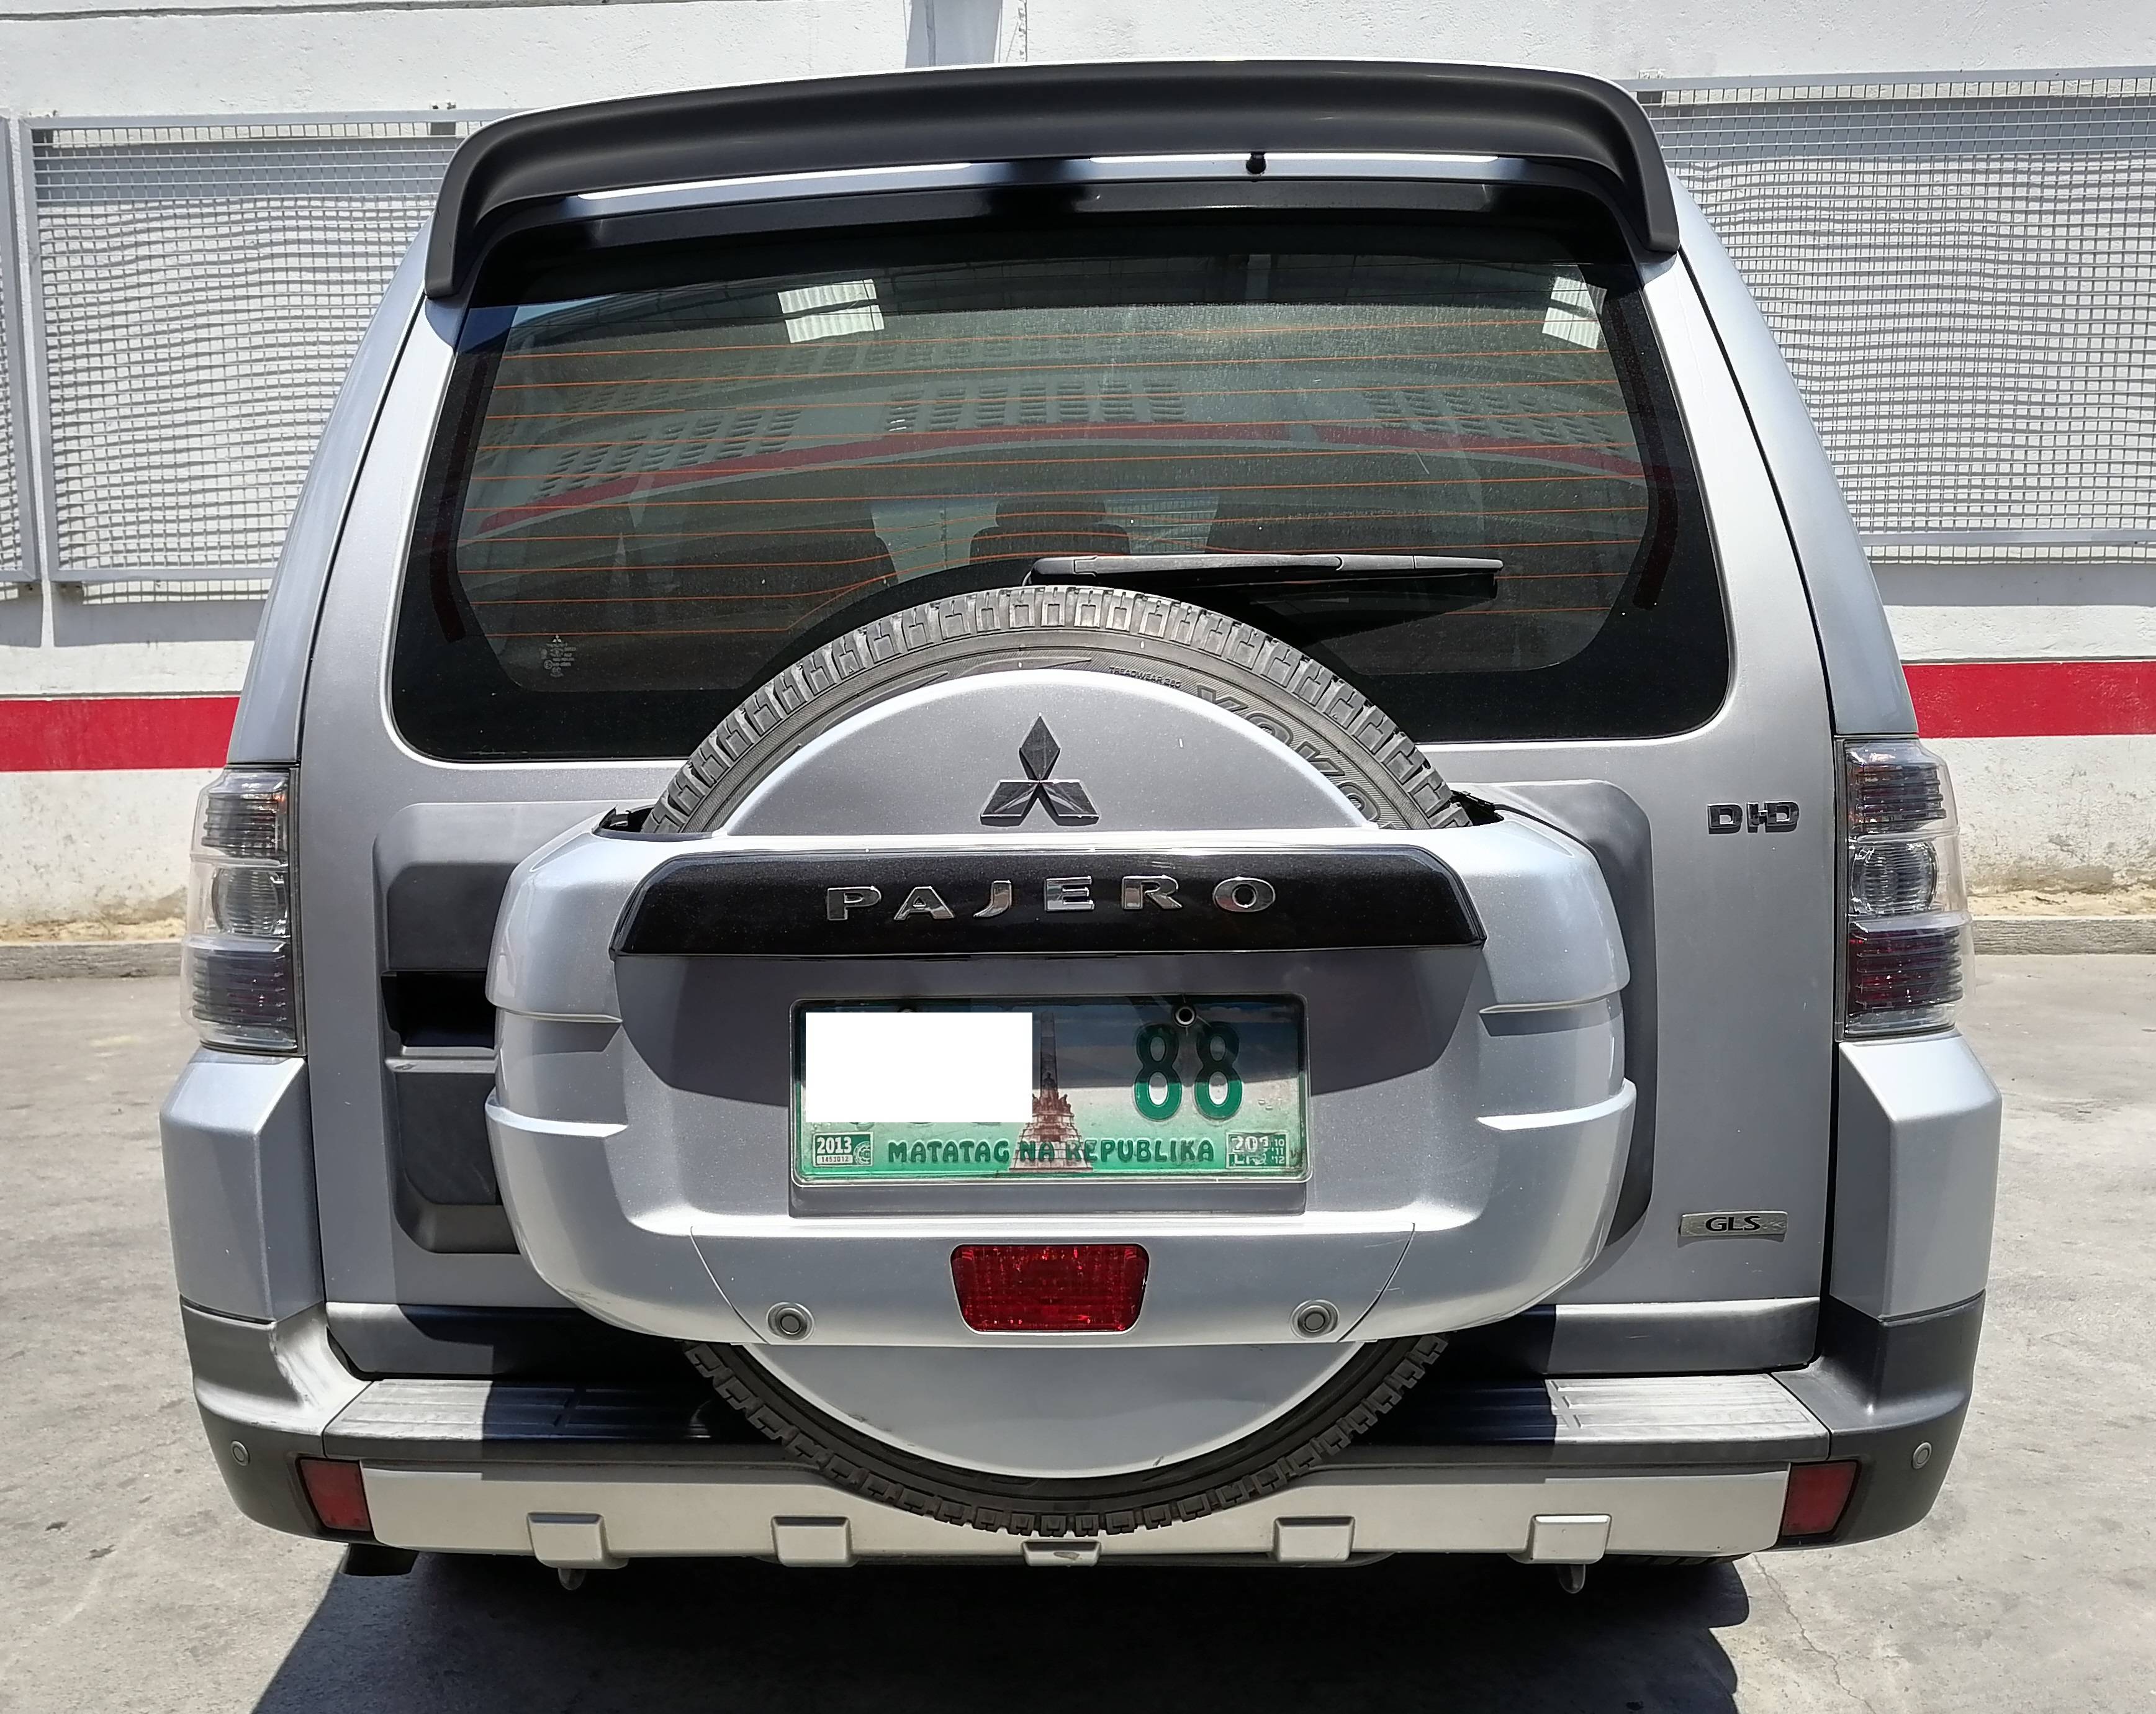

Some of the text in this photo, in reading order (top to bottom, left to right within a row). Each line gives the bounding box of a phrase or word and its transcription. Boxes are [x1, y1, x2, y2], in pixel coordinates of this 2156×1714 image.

[1109, 666, 1162, 683] TREADWEAR
[1197, 684, 1394, 829] YOKO
[826, 875, 1276, 921] PAJERO
[1134, 1022, 1243, 1120] 88
[816, 1137, 852, 1154] 2013
[888, 1139, 1010, 1163] MATATAG
[1019, 1140, 1056, 1162] NA
[1067, 1140, 1214, 1163] REPUBLIKA
[1705, 1216, 1761, 1232] GLS
